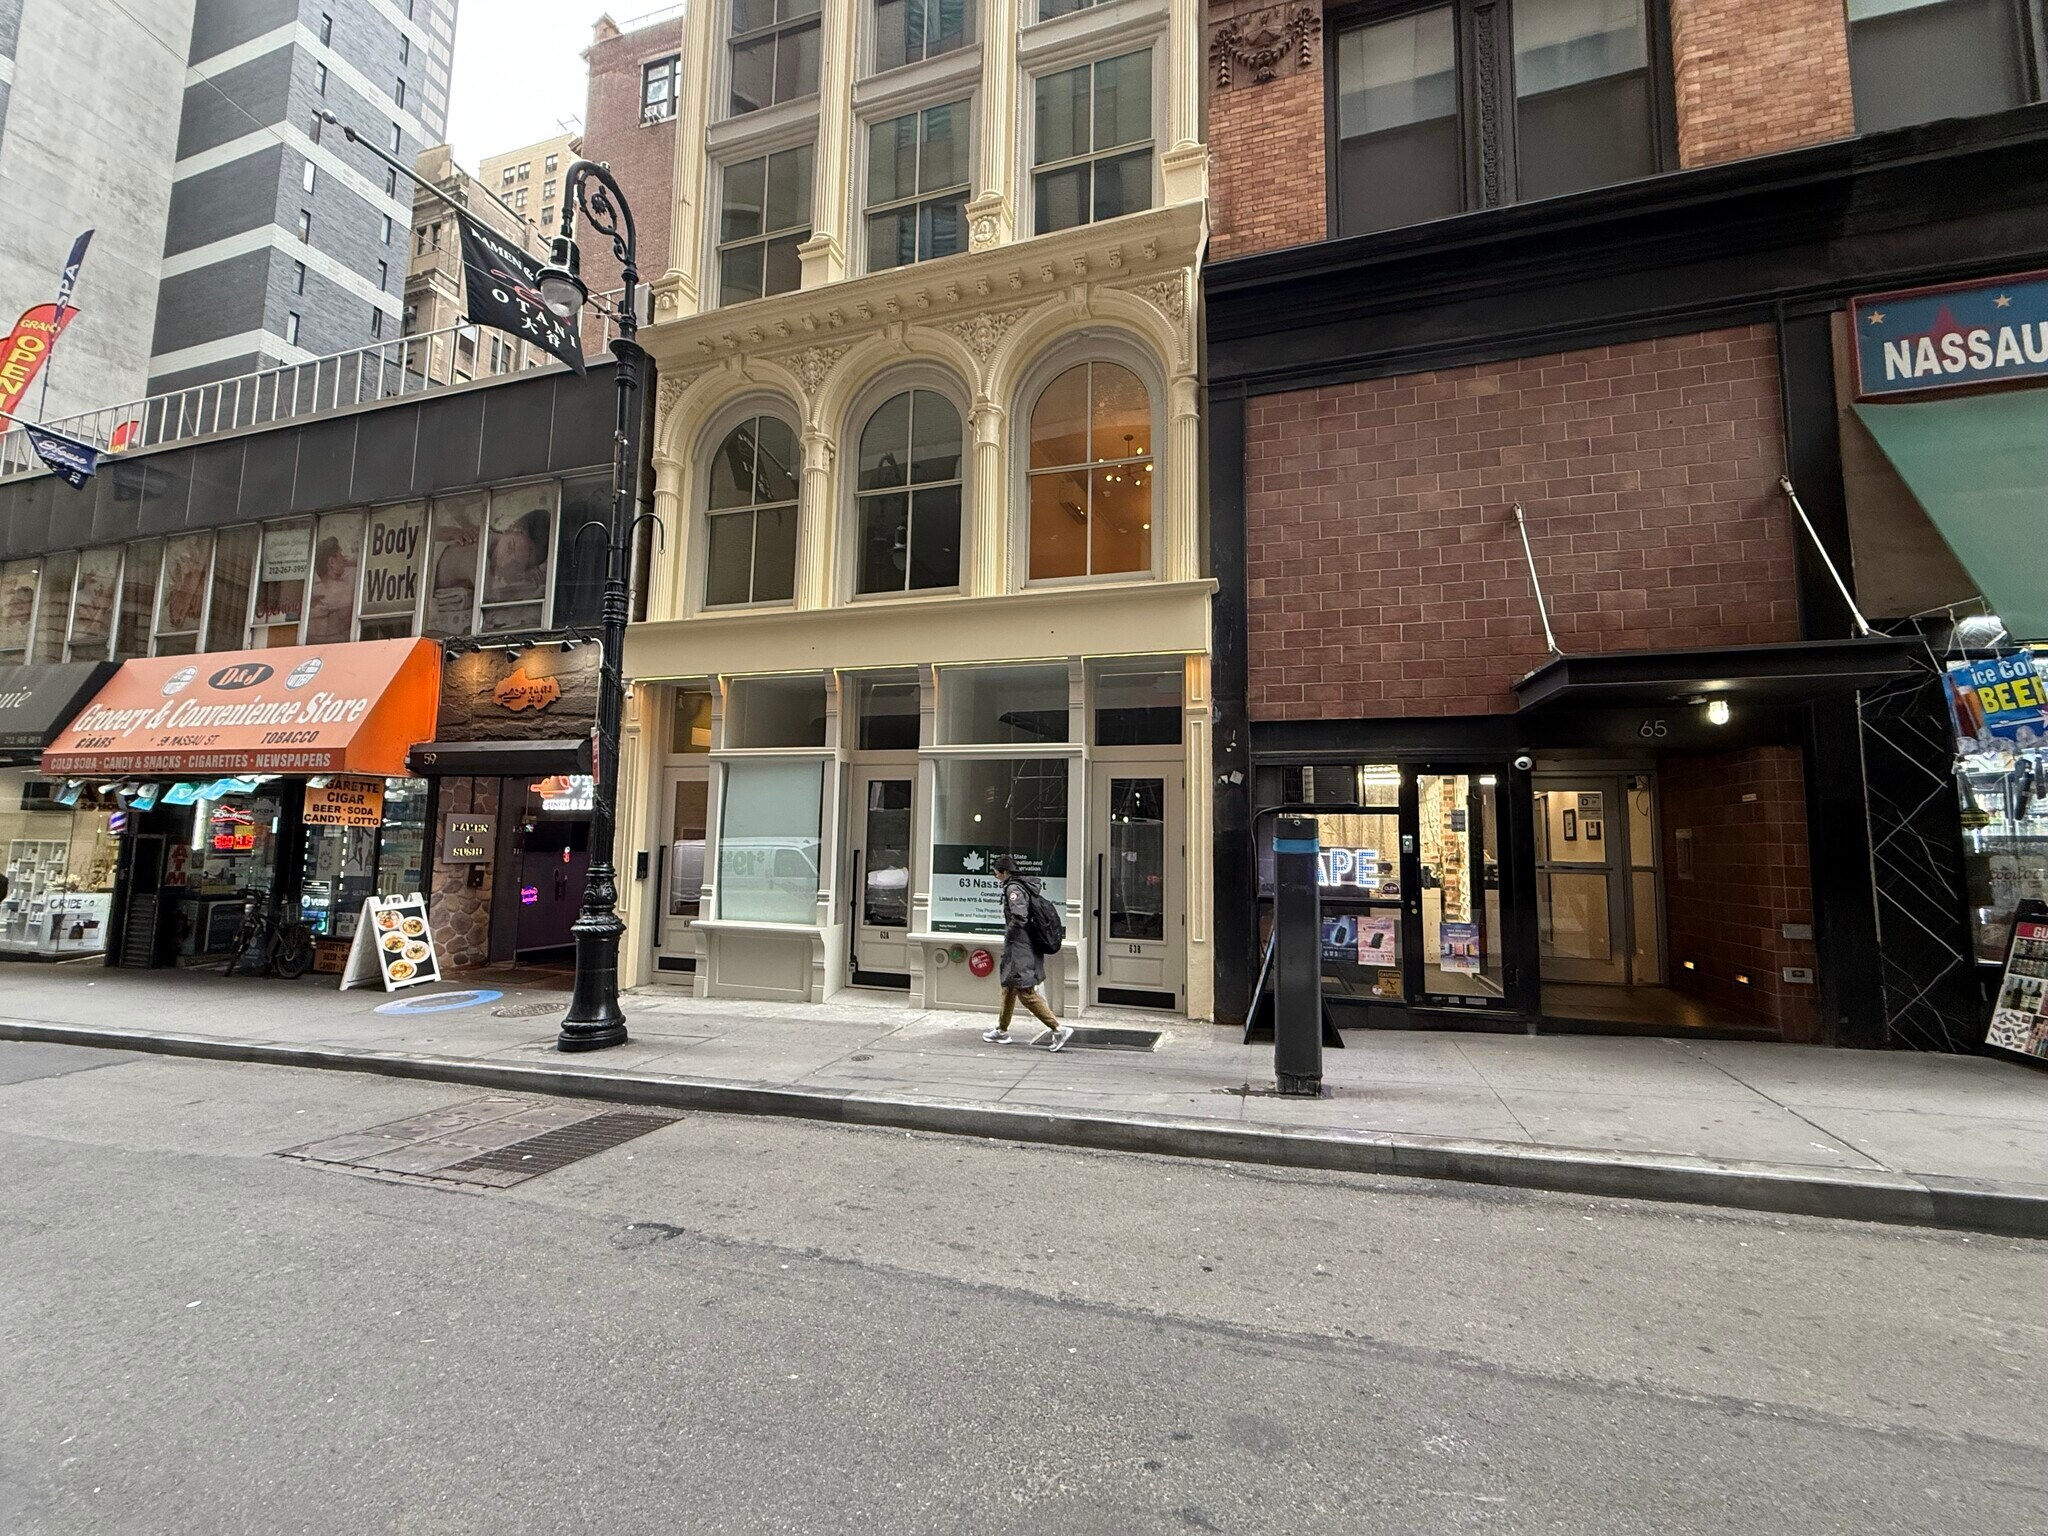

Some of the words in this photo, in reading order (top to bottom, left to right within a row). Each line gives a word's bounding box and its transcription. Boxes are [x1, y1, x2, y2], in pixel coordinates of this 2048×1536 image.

[57, 263, 79, 309] SPA
[1884, 322, 2048, 380] NASSAU
[372, 519, 419, 560] Body
[367, 565, 418, 603] Work
[1998, 655, 2033, 679] Col
[216, 666, 266, 686] D&J
[72, 703, 155, 738] Grocery
[144, 699, 175, 730] &
[166, 695, 302, 729] Convenience
[295, 692, 368, 724] Store
[1640, 720, 1667, 737] 65
[260, 731, 319, 745] TOBACCO
[51, 758, 73, 770] COLD
[74, 757, 97, 769] SODA
[103, 757, 133, 769] CANDY
[134, 757, 143, 768] &
[143, 756, 181, 769] SNACKS
[188, 754, 248, 768] CIGARETTES
[256, 753, 331, 767] NEWSPAPERS
[424, 753, 436, 765] 59
[325, 779, 380, 794] GARETTE
[327, 792, 365, 805] CIGAR
[312, 804, 341, 814] BEER
[347, 806, 374, 816] SODA
[303, 813, 341, 824] CANDY
[347, 816, 380, 826] LOTTO
[452, 823, 488, 833] RAMEN
[464, 835, 474, 845] &
[453, 848, 484, 857] SUSHI
[1318, 848, 1380, 888] APE
[959, 878, 971, 888] 63
[973, 878, 1004, 889] Nassa
[880, 931, 890, 940] 63A
